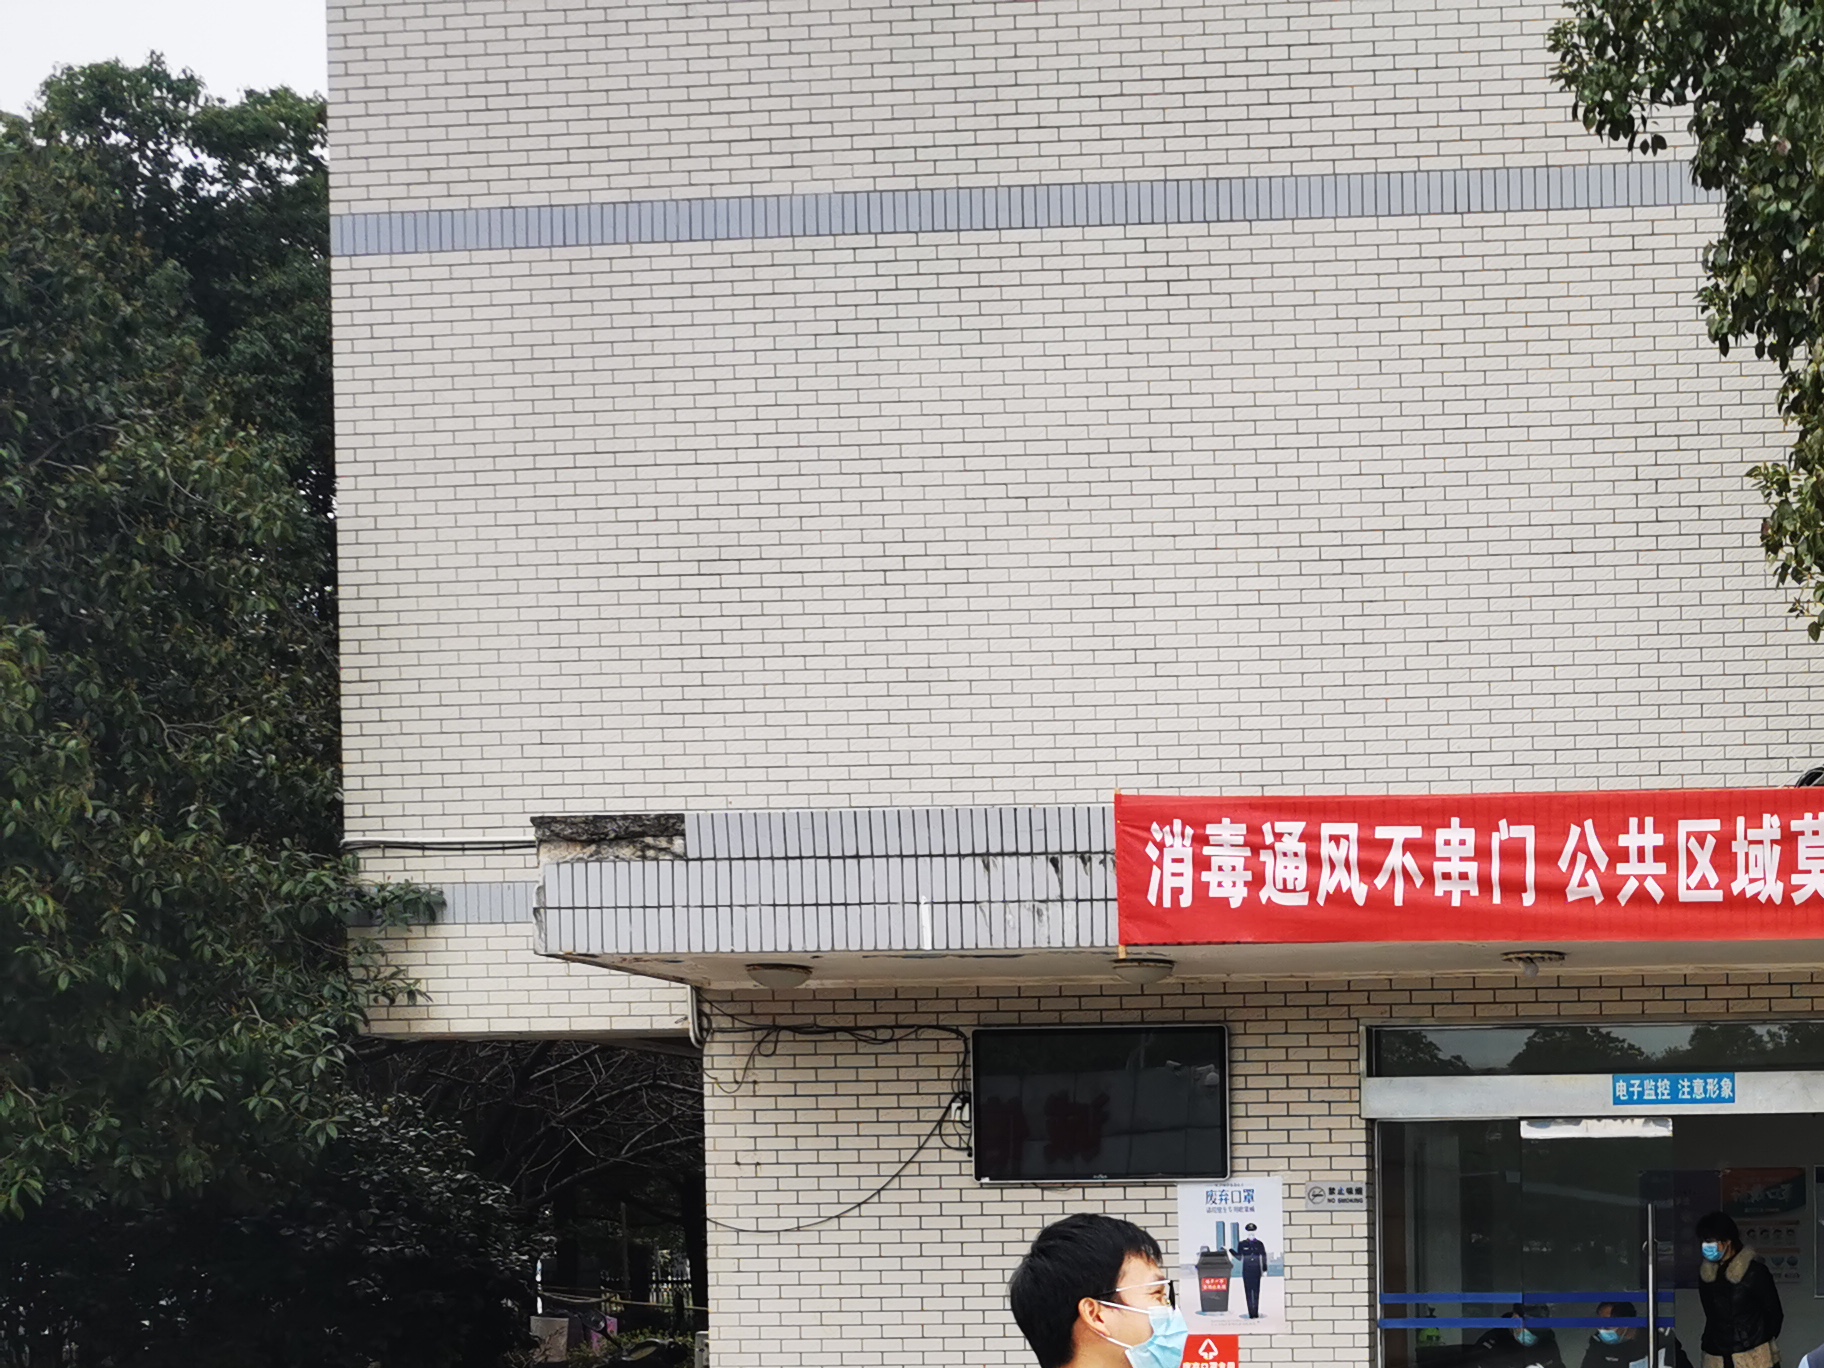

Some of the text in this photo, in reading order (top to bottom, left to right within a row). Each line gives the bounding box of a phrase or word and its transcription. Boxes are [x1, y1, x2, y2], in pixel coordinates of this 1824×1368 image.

[1145, 817, 1537, 909] 消毒通风不串门
[1615, 1077, 1733, 1100] 电子监控 注意形象
[1205, 1189, 1255, 1205] 废弃口罩
[1328, 1186, 1363, 1196] 禁止吸烟
